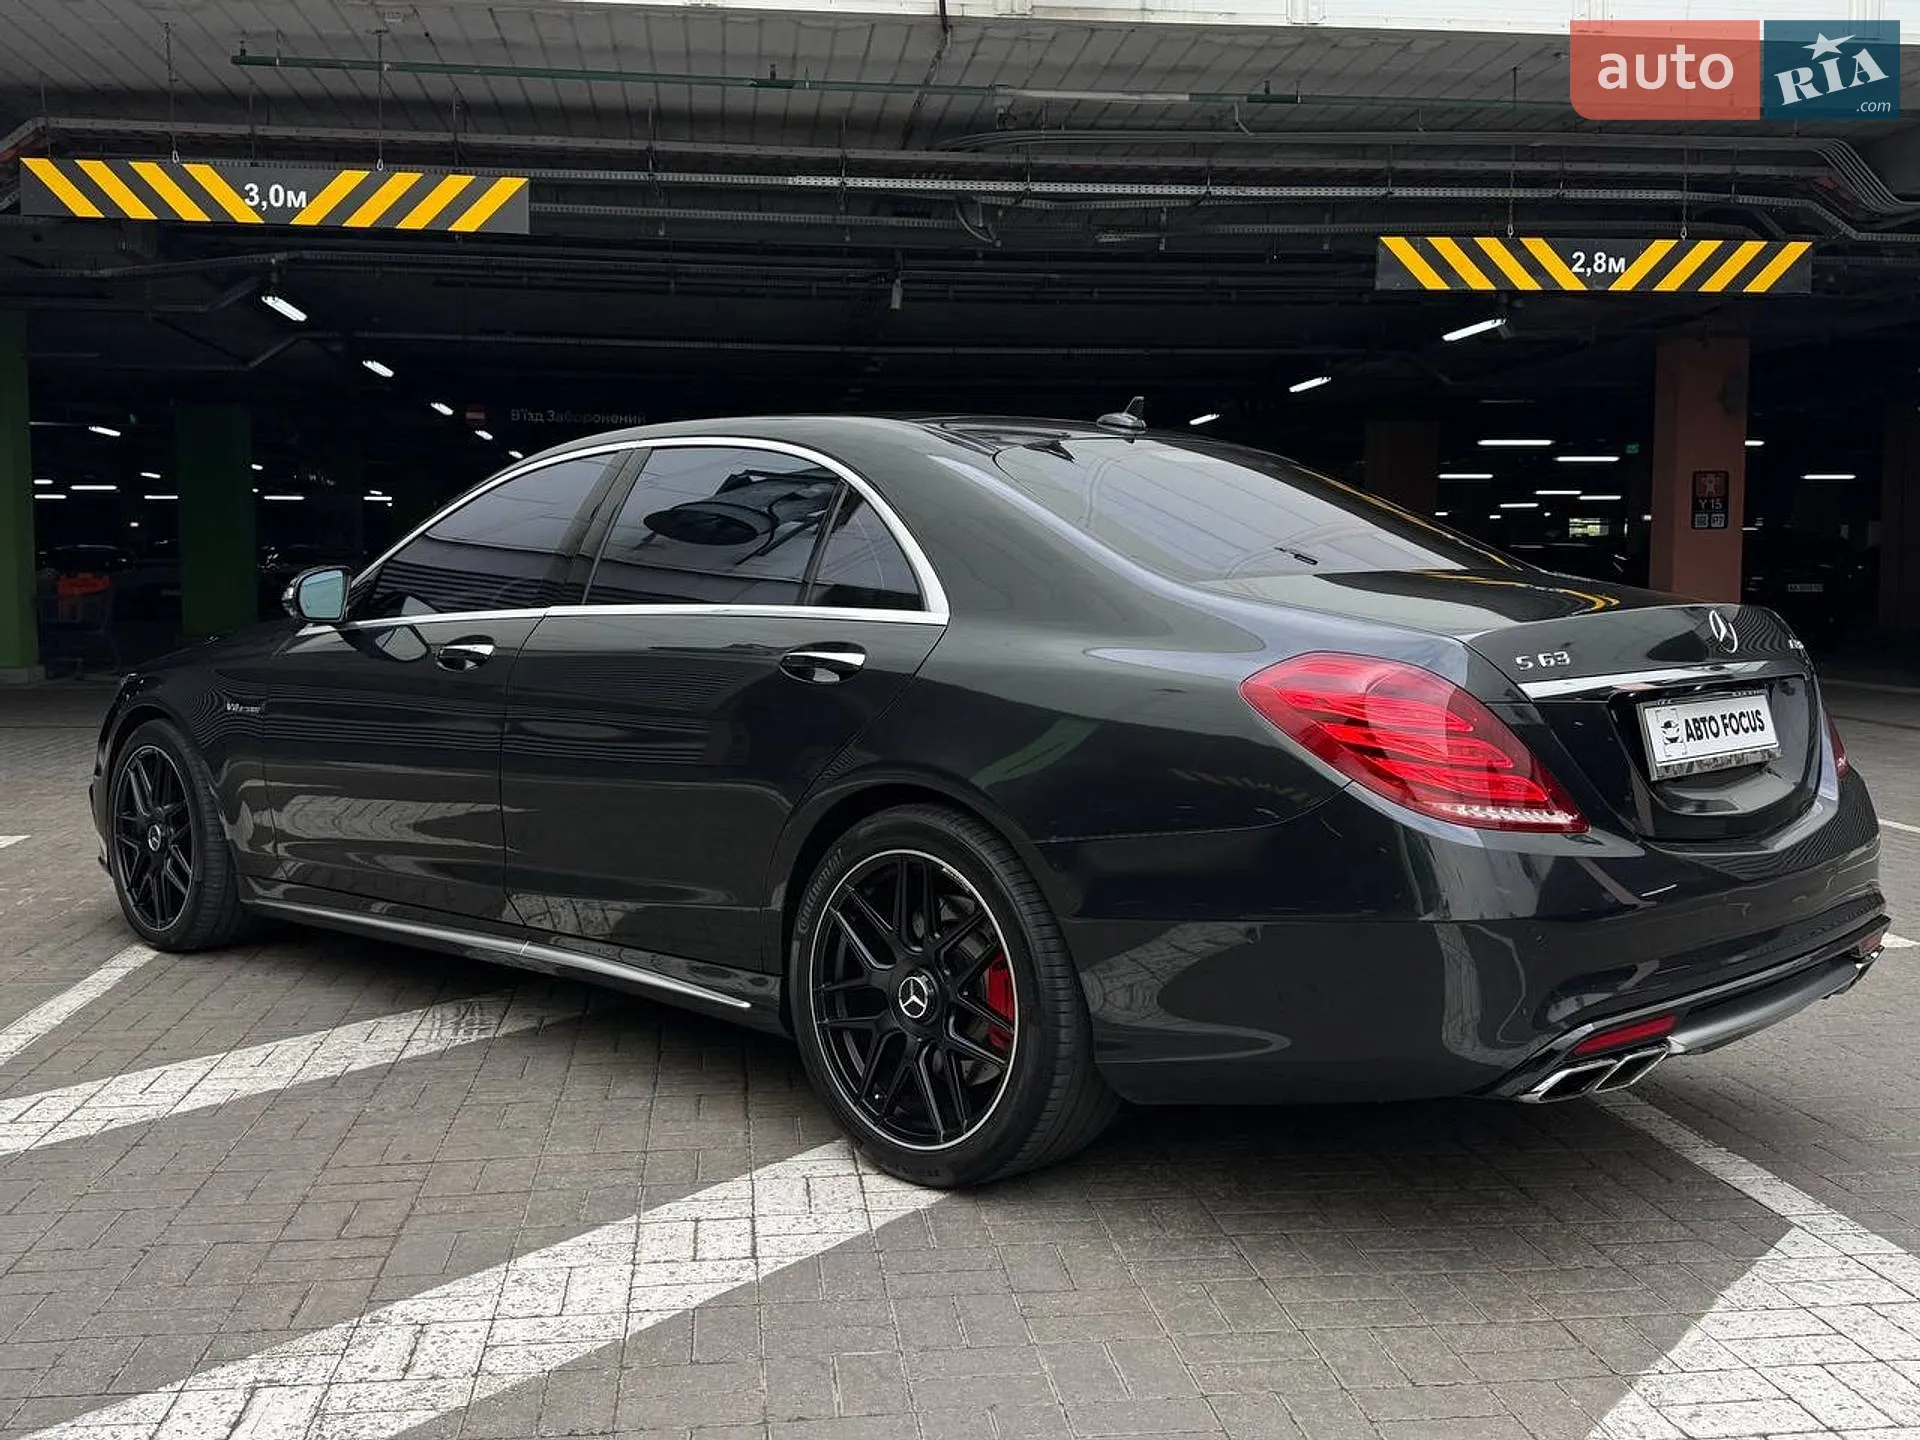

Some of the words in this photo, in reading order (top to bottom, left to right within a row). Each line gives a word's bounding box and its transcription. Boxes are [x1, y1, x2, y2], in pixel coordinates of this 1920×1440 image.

[244, 183, 307, 211] 3,0м
[1571, 251, 1626, 277] 2,8м
[1515, 655, 1534, 671] S
[1537, 650, 1571, 668] 63
[1721, 709, 1767, 737] FOCUS
